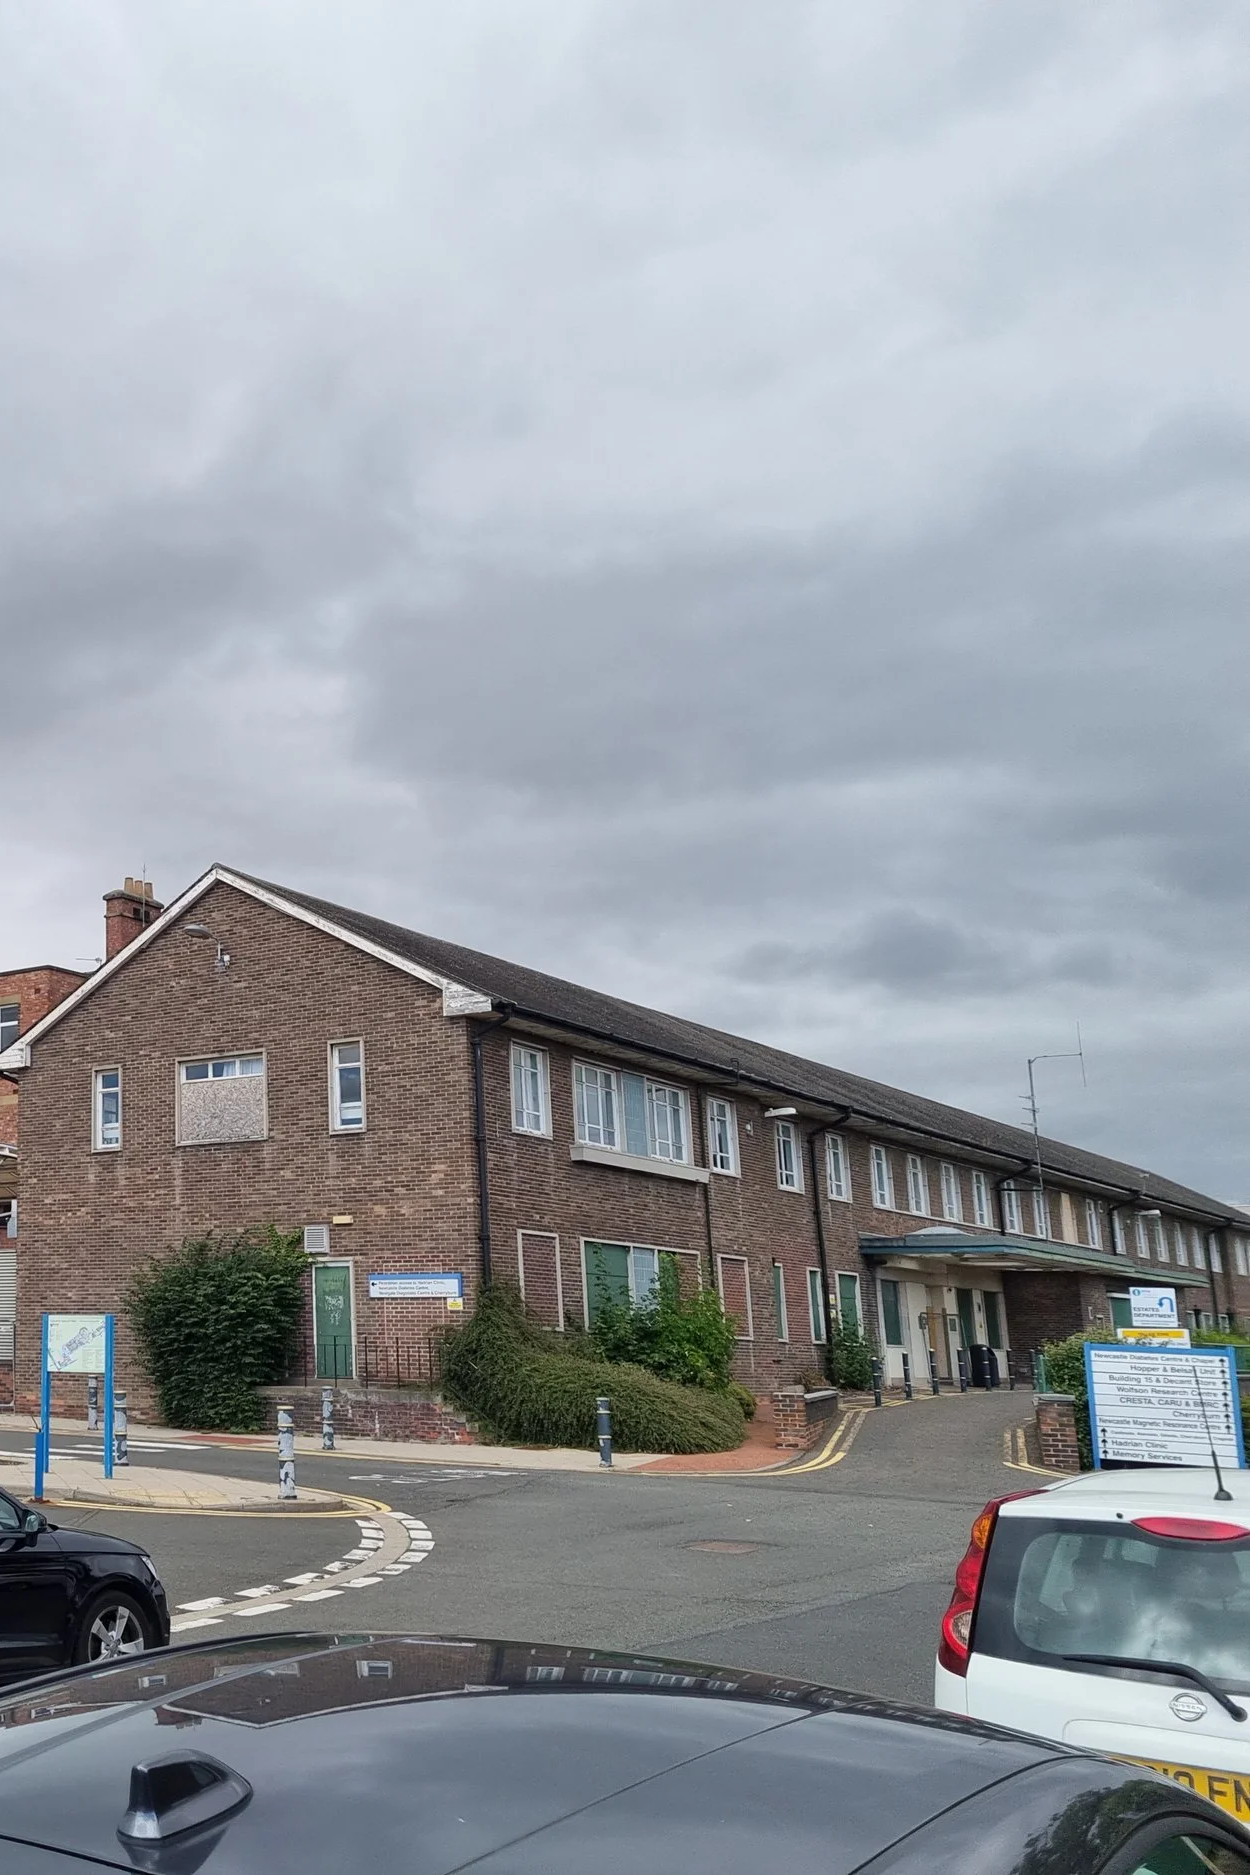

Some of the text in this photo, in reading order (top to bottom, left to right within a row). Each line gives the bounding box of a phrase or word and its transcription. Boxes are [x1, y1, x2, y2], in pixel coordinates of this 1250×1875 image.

[1094, 1352, 1128, 1360] Newcastle
[1170, 1366, 1196, 1374] Belsa
[1108, 1374, 1142, 1383] Building
[1163, 1377, 1192, 1385] Decant
[1099, 1417, 1131, 1425] Newcastle
[1132, 1419, 1162, 1427] Magnetic
[1162, 1421, 1198, 1429] Resonance
[1111, 1440, 1168, 1449] Hadrian Clinic
[1112, 1450, 1183, 1461] Memory Services
